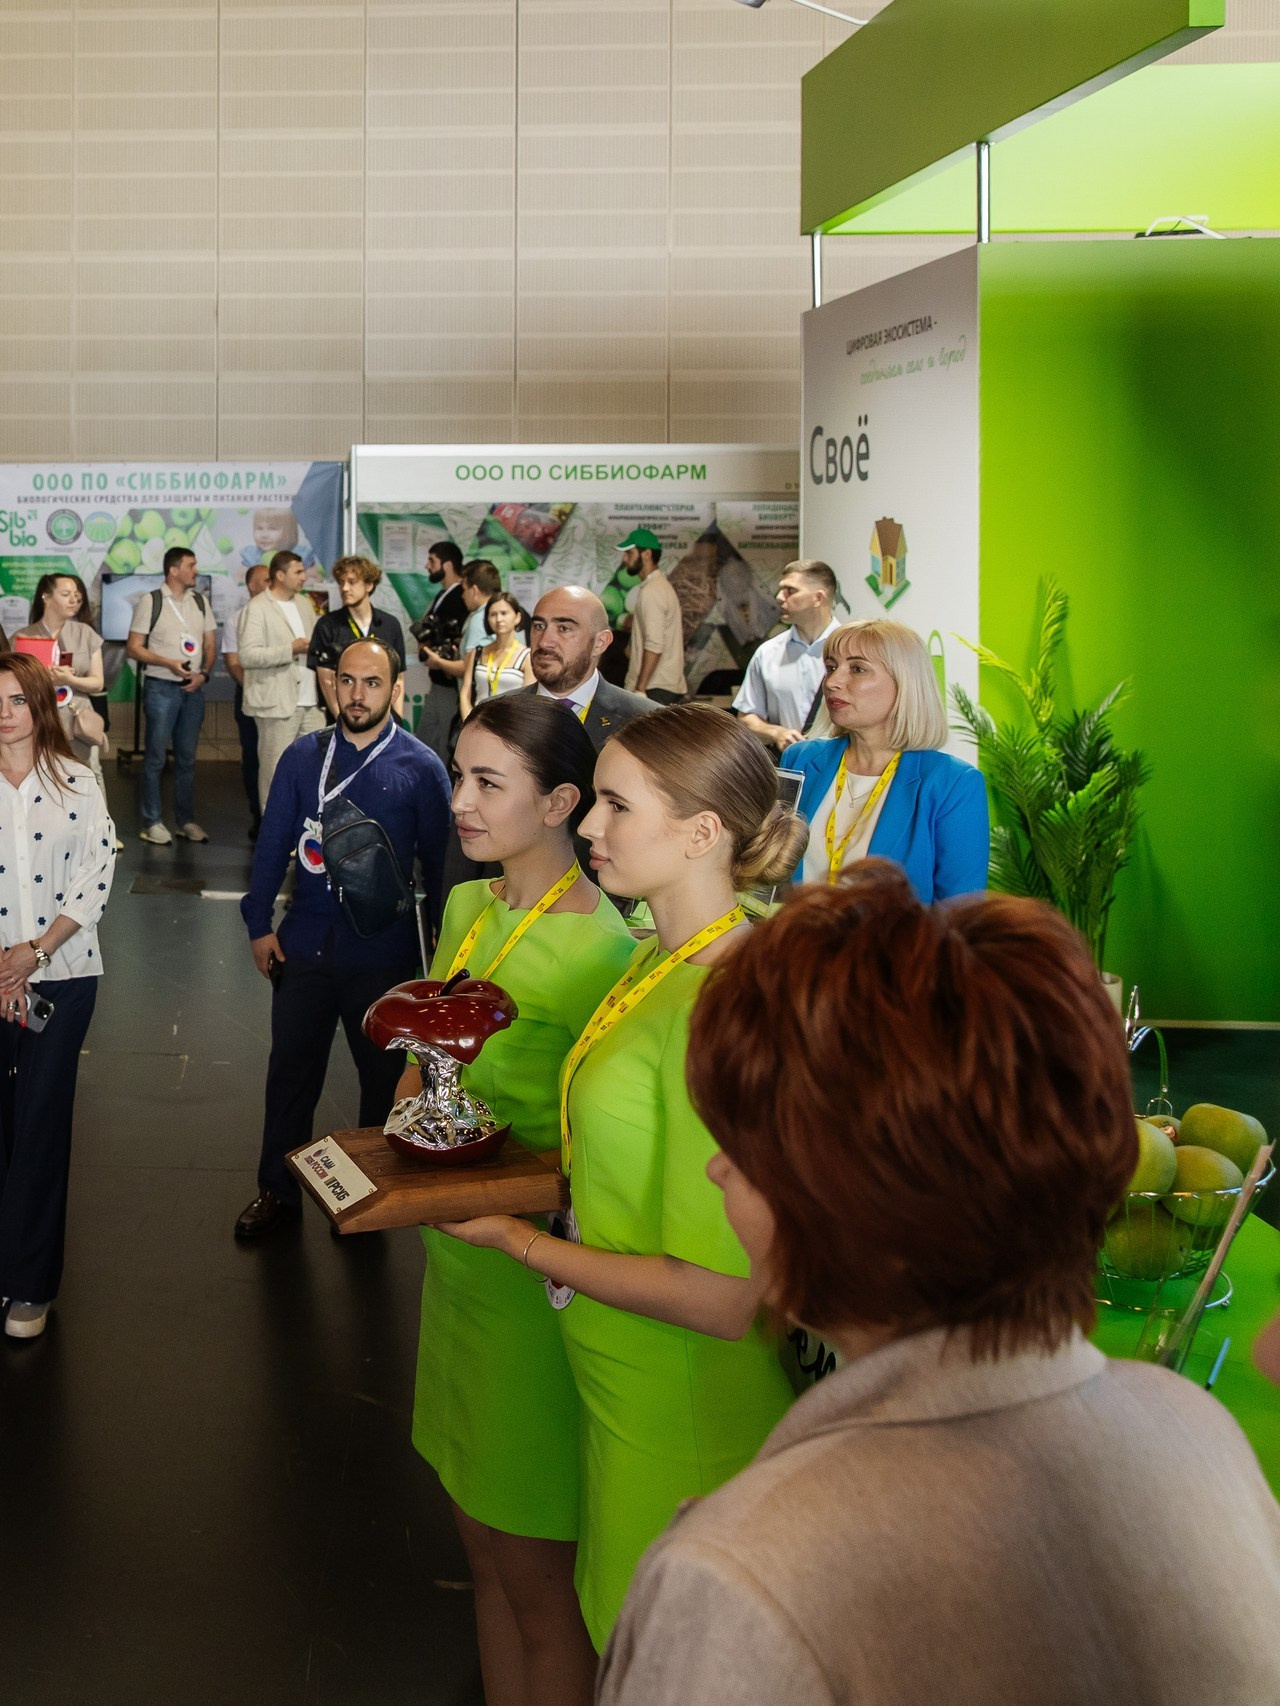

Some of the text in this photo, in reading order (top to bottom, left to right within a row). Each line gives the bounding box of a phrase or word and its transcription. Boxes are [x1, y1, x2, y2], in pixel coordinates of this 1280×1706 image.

[809, 414, 870, 485] Своё
[32, 471, 287, 491] ООО ПО «СИББИОФАРМ»
[455, 464, 707, 482] ООО ПО СИББИОФАРМ
[16, 495, 92, 504] БИОЛОГИЧЕСКИЕ
[94, 495, 138, 504] СРЕДСТВА
[141, 495, 162, 503] ДЛЯ
[163, 495, 201, 503] ЗАЩИТЫ
[9, 530, 38, 547] bio
